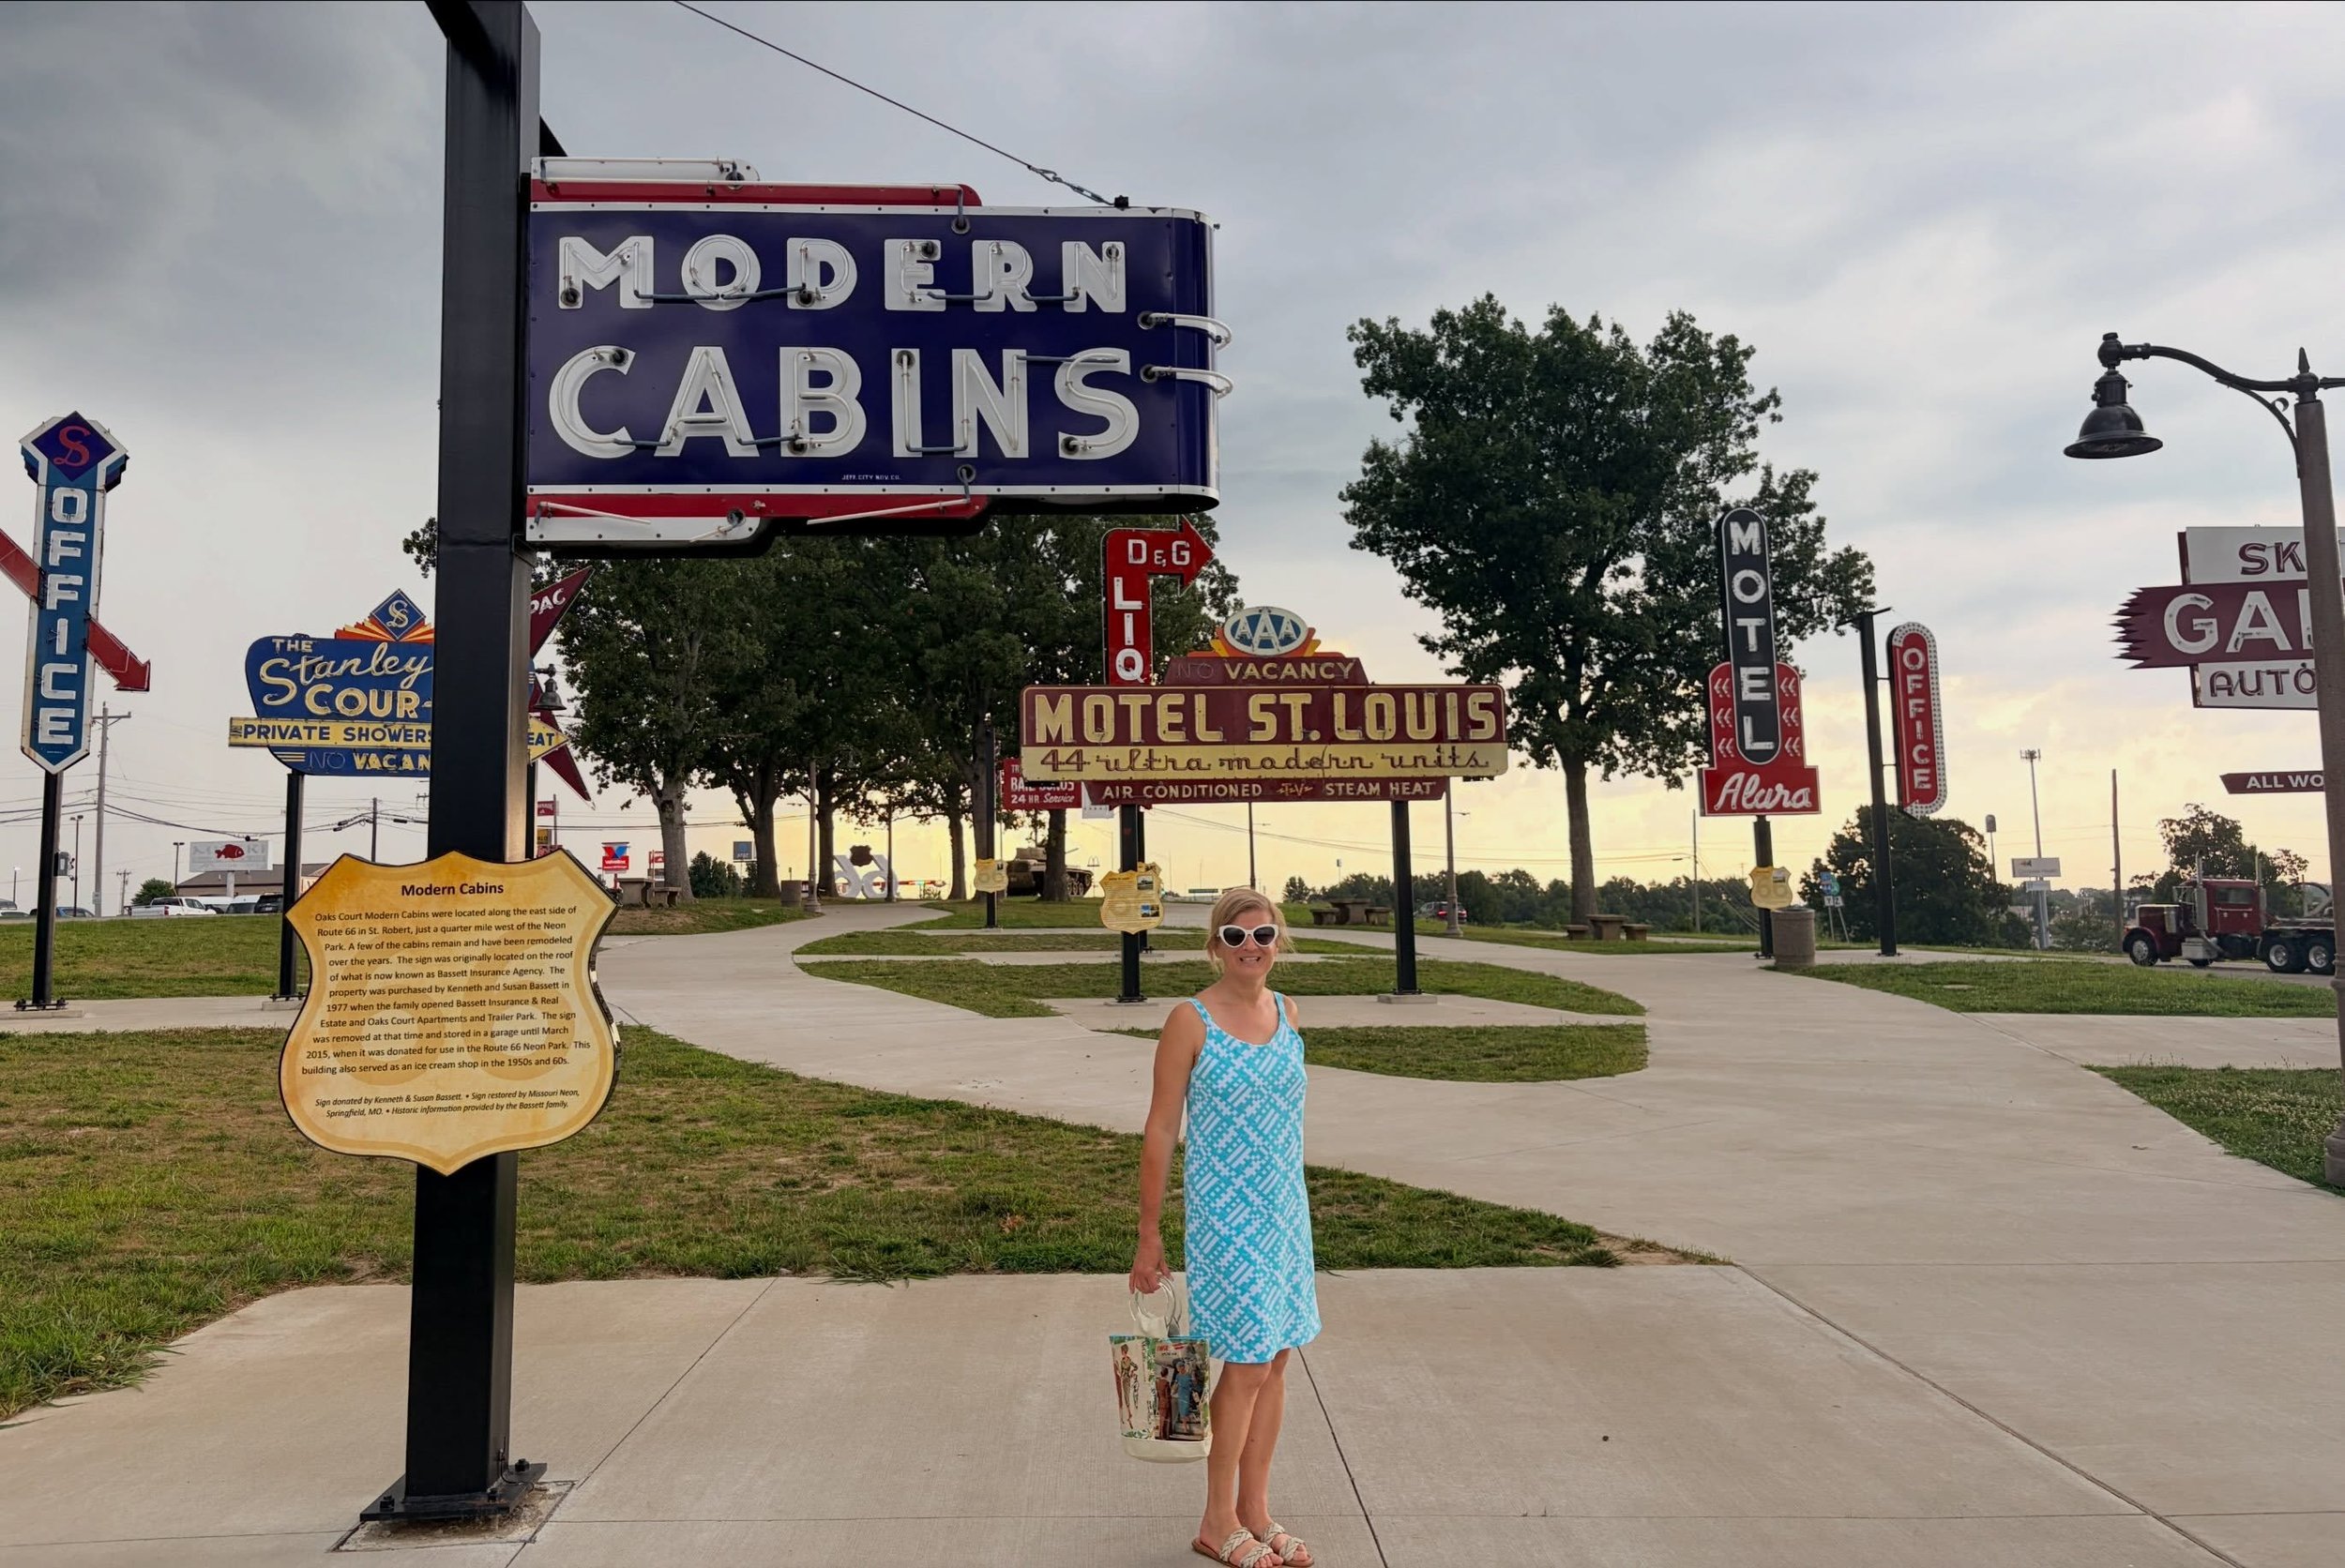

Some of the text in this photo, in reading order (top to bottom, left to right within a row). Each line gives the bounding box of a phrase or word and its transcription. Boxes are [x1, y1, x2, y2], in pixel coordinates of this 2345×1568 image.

[558, 234, 1127, 312] MODERN
[549, 345, 1140, 460] CABINS
[38, 486, 88, 745] OFFICE
[1113, 577, 1145, 683] LIQ
[1234, 611, 1298, 652] AAA
[1730, 520, 1775, 750] MOTEL
[271, 639, 313, 654] THE
[260, 642, 433, 705] Stanley
[1177, 661, 1357, 680] NO VACANCY
[2209, 669, 2317, 697] AUTO
[305, 684, 432, 719] COUR
[1035, 692, 1497, 744] MOTEL ST. LOUIS
[1903, 647, 1932, 790] OFFICE
[243, 724, 330, 741] PRIVATE
[310, 751, 345, 769] NO
[1040, 745, 1490, 772] 44 ultra modern units
[1103, 785, 1134, 798] AIR
[1142, 783, 1263, 799] CONDITIONED
[1324, 782, 1381, 796] STEAM
[1389, 781, 1436, 796] HEAT
[1715, 772, 1813, 811] Alura
[2247, 776, 2284, 789] ALL
[1011, 792, 1075, 804] 24 HR Service
[401, 882, 504, 896] Modern Cabins
[401, 910, 430, 918] Cabins
[455, 909, 486, 917] located
[488, 909, 511, 917] along
[549, 906, 566, 914] side
[567, 906, 577, 914] of
[317, 927, 343, 936] Route
[345, 927, 356, 935] 66
[369, 927, 379, 935] St.
[415, 926, 431, 935] just
[516, 922, 525, 930] of
[325, 942, 346, 951] Park.
[356, 942, 373, 950] few
[374, 941, 385, 949] of
[386, 941, 401, 949] the
[463, 938, 479, 946] and
[481, 938, 502, 946] have
[526, 936, 572, 944] remodeled
[367, 957, 392, 966] years.
[416, 956, 432, 964] sign
[453, 954, 492, 963] originally
[493, 953, 524, 961] located
[539, 951, 553, 959] the
[329, 972, 340, 982] of
[340, 972, 363, 981] what
[365, 972, 371, 980] is
[512, 968, 545, 976] Agency.
[550, 966, 565, 974] The
[329, 988, 367, 998] property
[388, 986, 432, 996] purchased
[435, 985, 445, 994] by
[447, 984, 482, 992] Kenneth
[484, 983, 500, 991] and
[326, 1003, 348, 1012] 1977
[376, 1002, 391, 1010] the
[393, 1001, 419, 1010] family
[421, 1000, 453, 1009] opened
[532, 996, 538, 1004] &
[541, 996, 558, 1004] Real
[321, 1019, 347, 1028] Estate
[349, 1018, 365, 1026] and
[368, 1018, 388, 1026] Oaks
[390, 1017, 415, 1025] Court
[416, 1016, 467, 1025] Apartments
[516, 1012, 537, 1020] Park.
[559, 1012, 576, 1020] sign
[332, 1033, 371, 1042] removed
[426, 1031, 442, 1039] and
[444, 1030, 471, 1038] stored
[490, 1030, 519, 1038] garage
[521, 1027, 539, 1035] until
[542, 1026, 568, 1034] March
